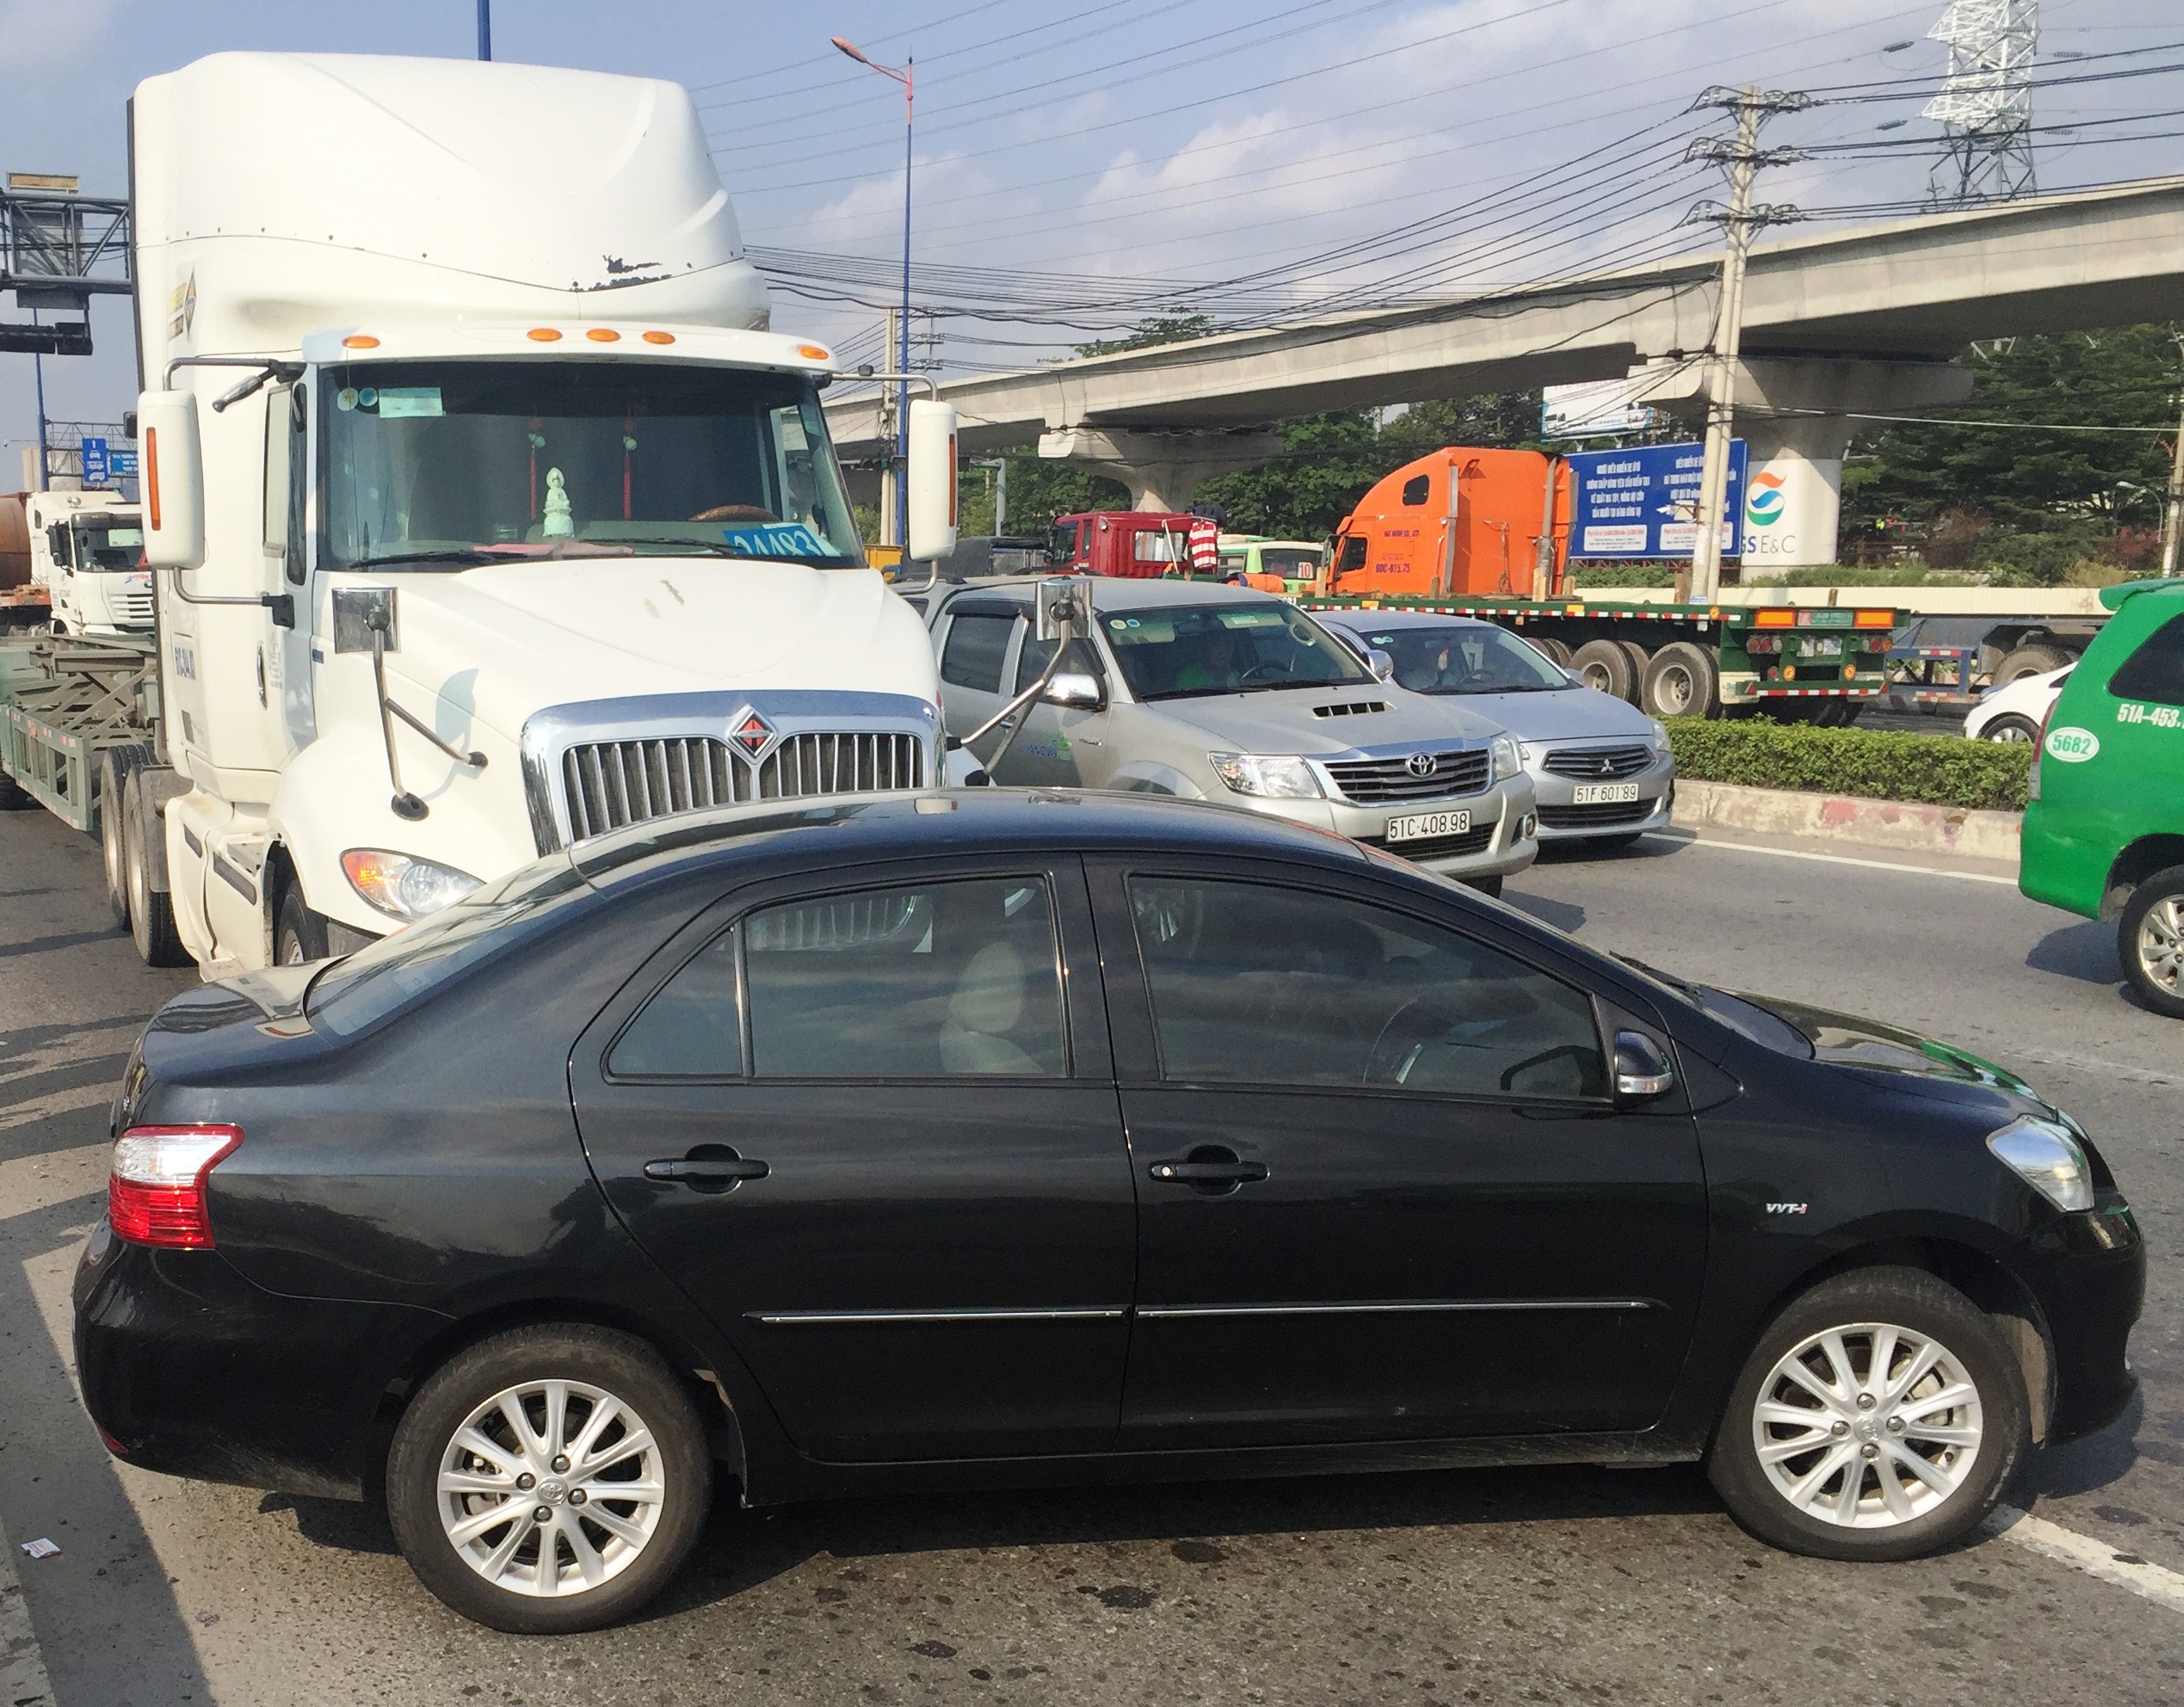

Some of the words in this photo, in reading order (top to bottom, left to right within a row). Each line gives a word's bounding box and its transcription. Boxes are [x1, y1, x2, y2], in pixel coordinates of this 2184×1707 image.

[1761, 535, 1796, 554] E&C
[1299, 564, 1311, 577] 10
[2117, 703, 2184, 730] 51A-453.
[2052, 734, 2091, 755] 5682
